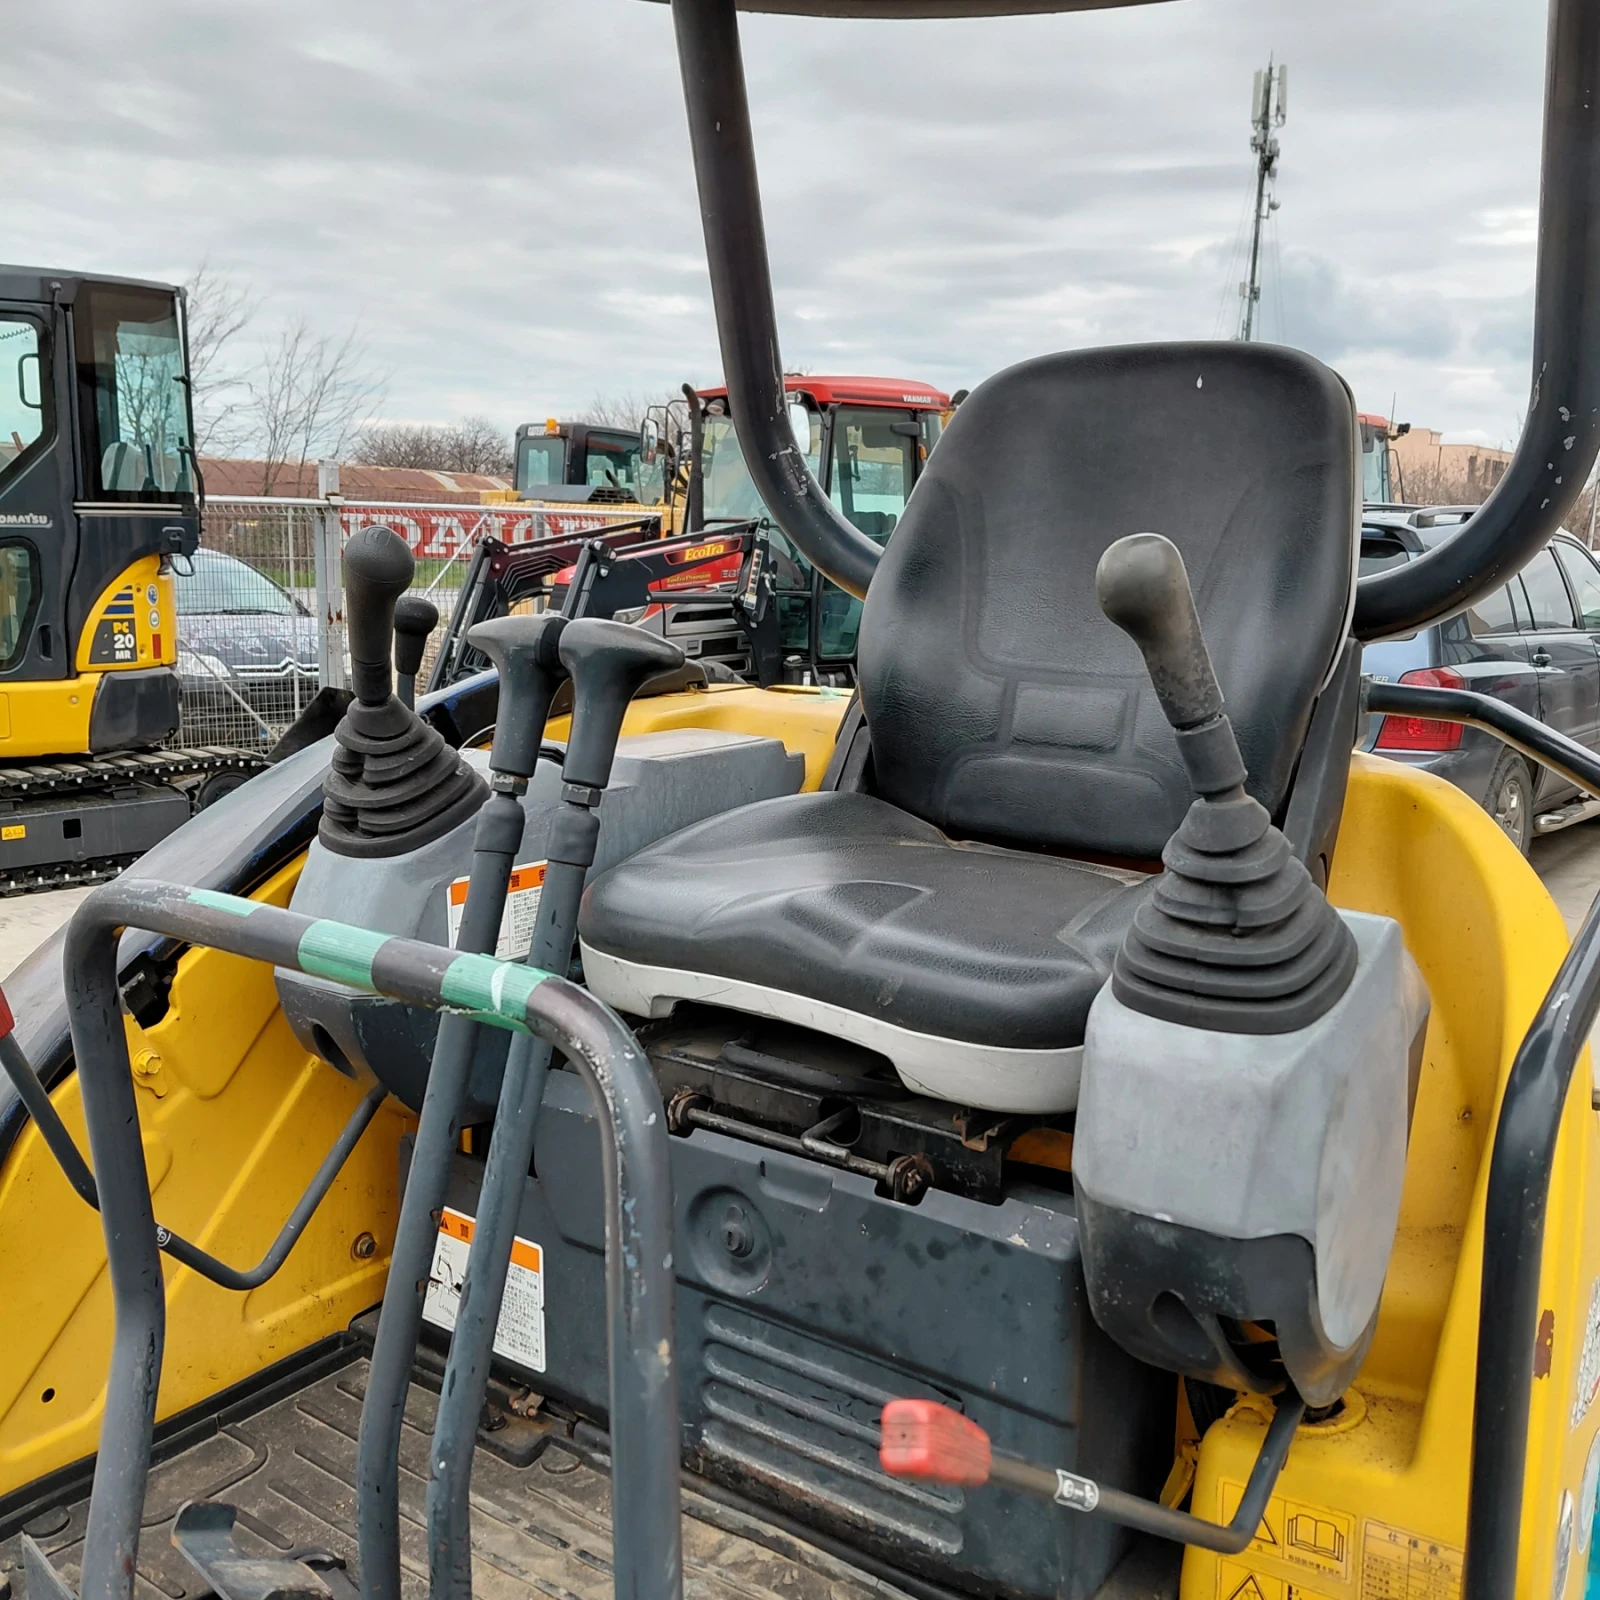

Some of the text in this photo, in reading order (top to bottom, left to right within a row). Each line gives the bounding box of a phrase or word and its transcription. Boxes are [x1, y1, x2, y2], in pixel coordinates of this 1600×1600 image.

[902, 394, 932, 404] YANMAR
[684, 543, 725, 562] EcoTra
[112, 621, 130, 634] PC
[113, 633, 135, 649] 20
[115, 650, 131, 660] MR
